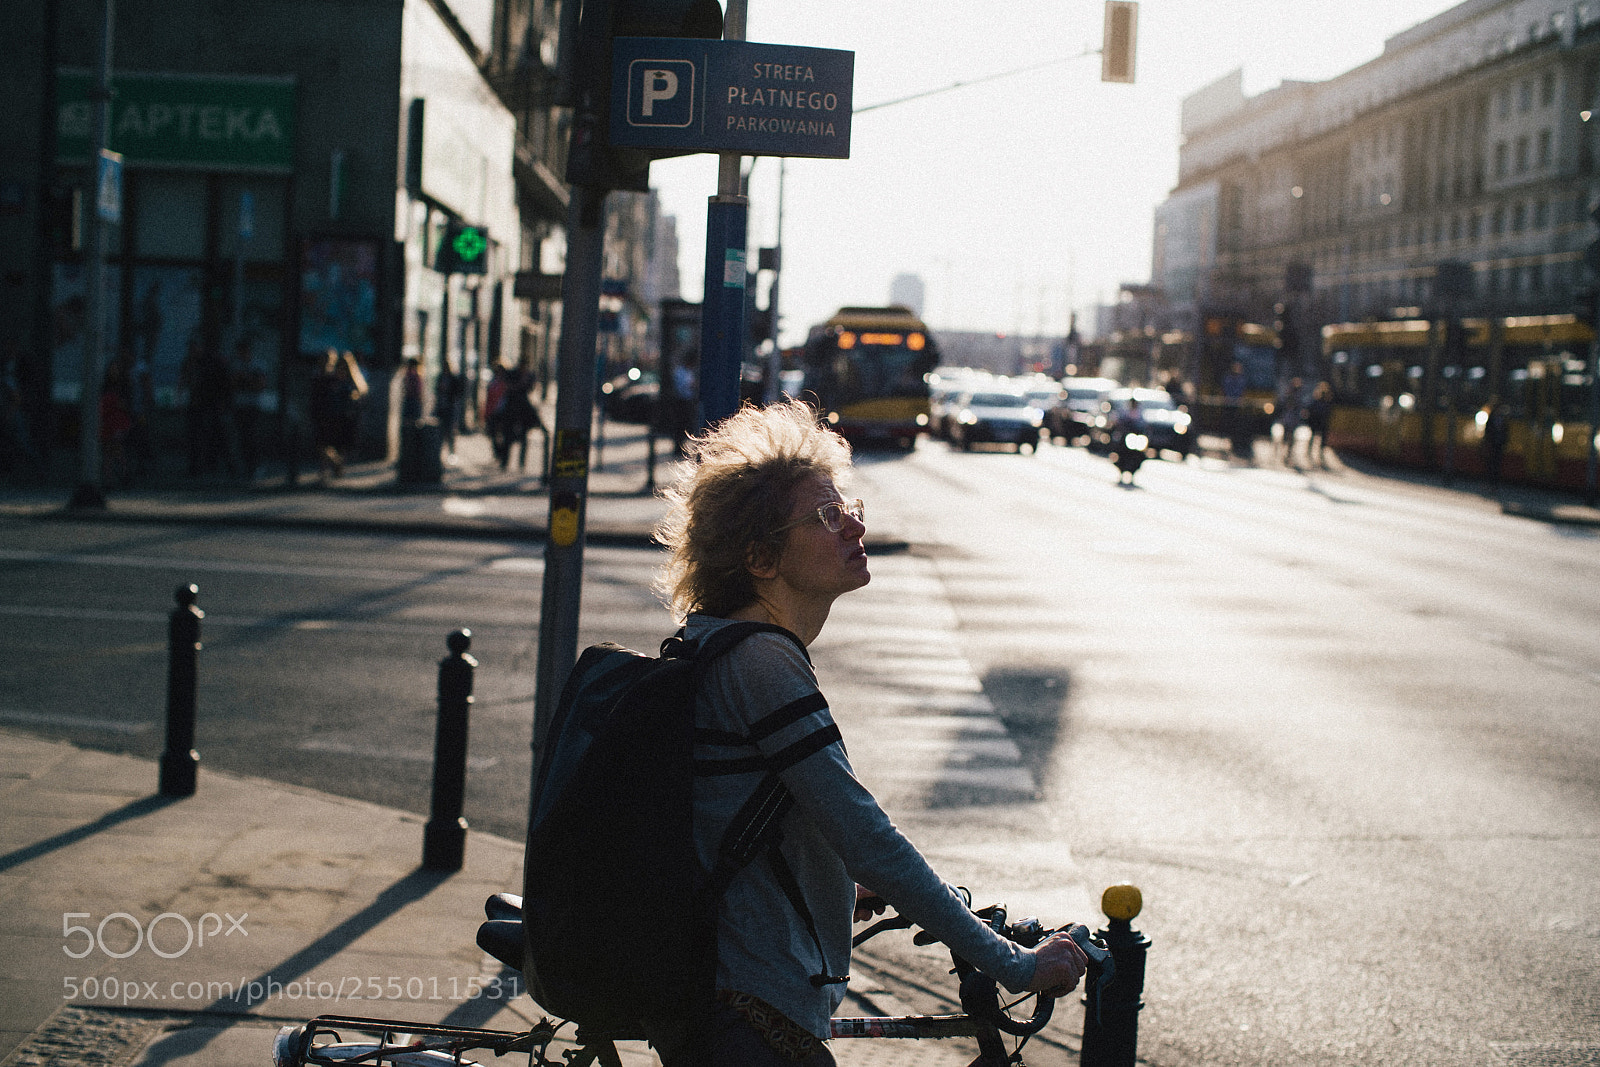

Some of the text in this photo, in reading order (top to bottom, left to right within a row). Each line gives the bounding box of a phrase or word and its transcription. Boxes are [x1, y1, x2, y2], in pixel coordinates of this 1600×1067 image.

[753, 63, 815, 82] STREFA
[641, 69, 679, 117] P
[727, 86, 838, 111] PŁATNEGO
[117, 103, 282, 139] APTEKA
[726, 115, 836, 137] PARKOWANIA
